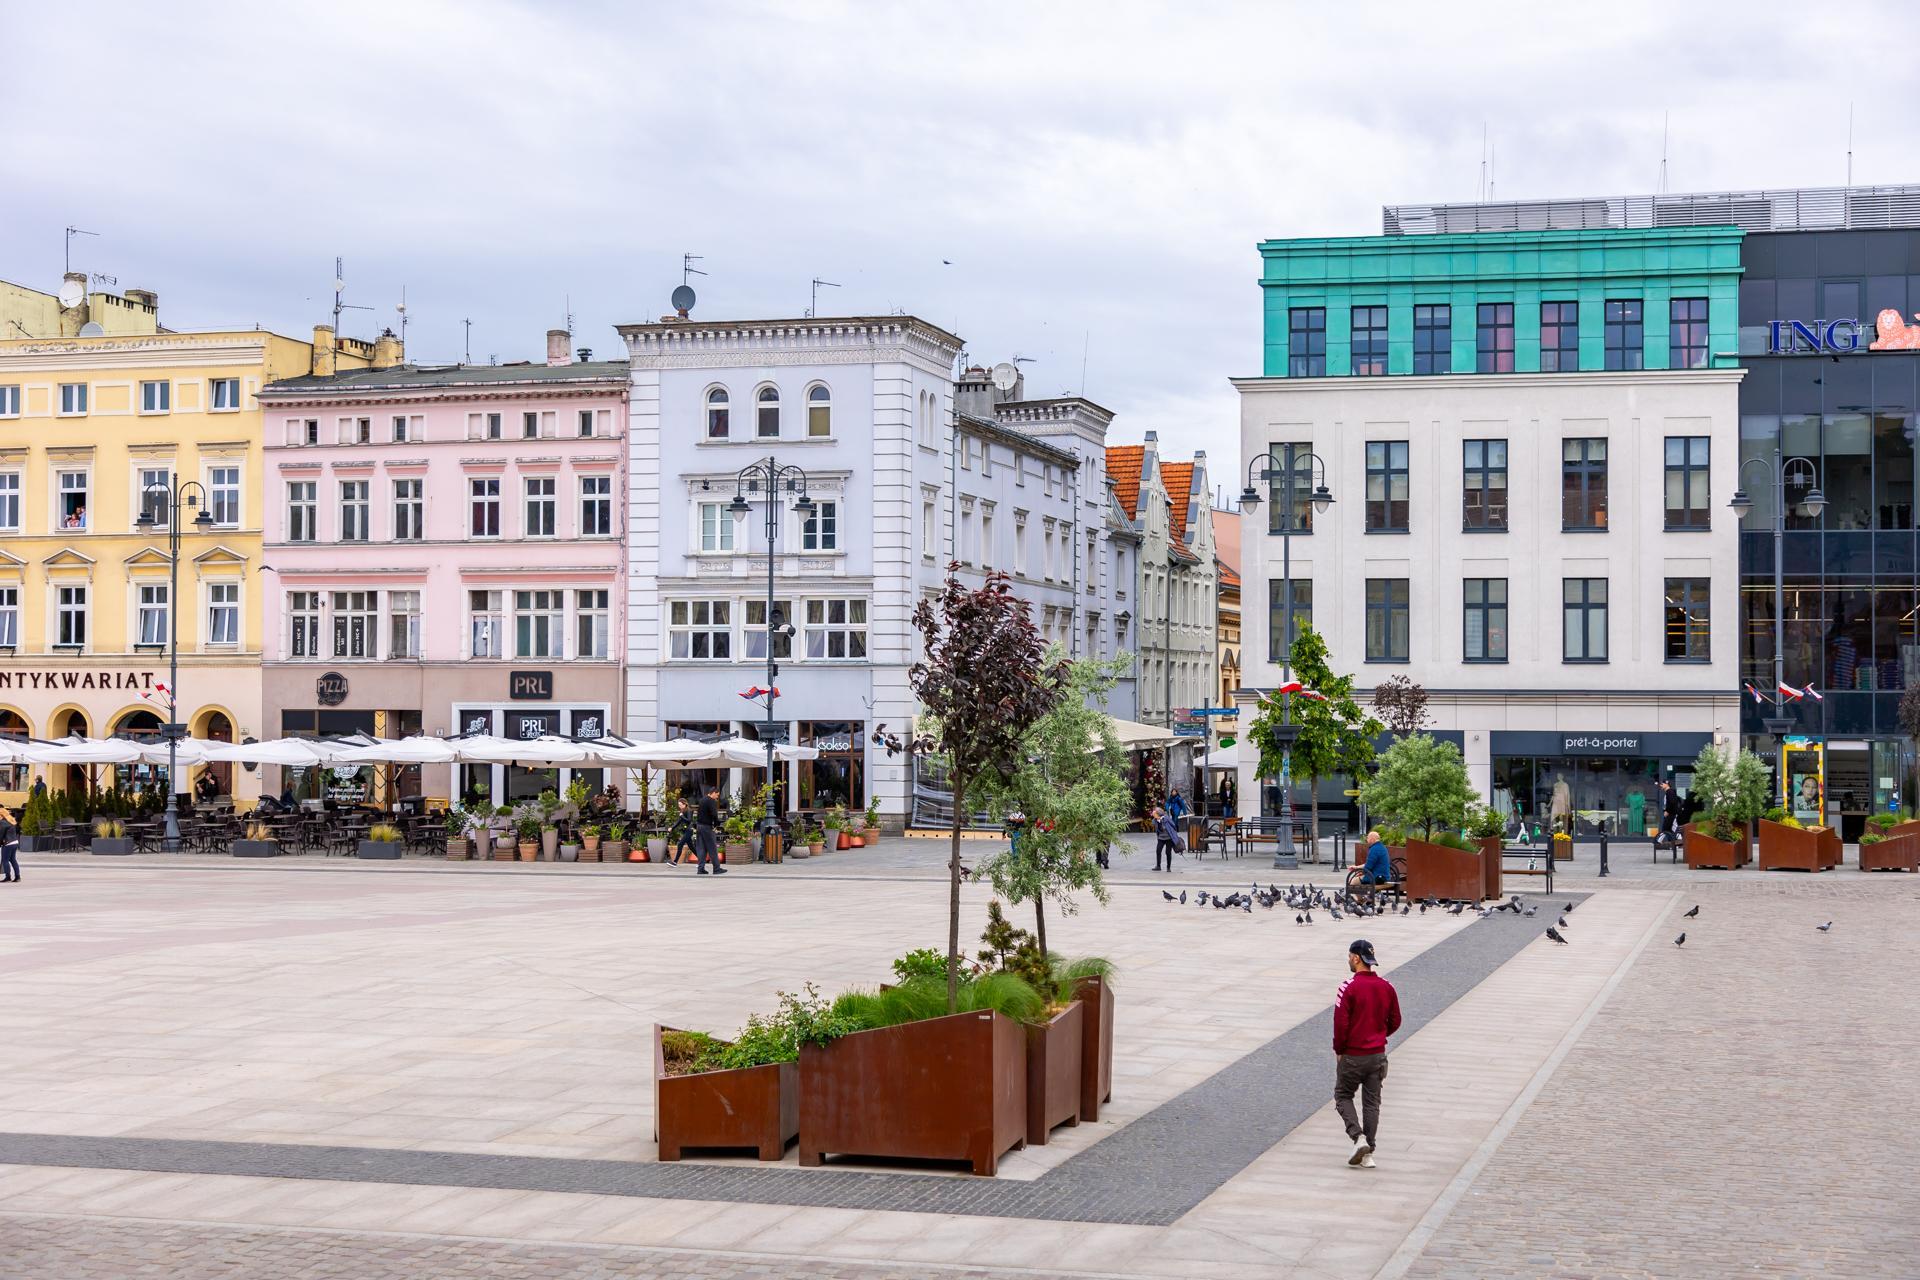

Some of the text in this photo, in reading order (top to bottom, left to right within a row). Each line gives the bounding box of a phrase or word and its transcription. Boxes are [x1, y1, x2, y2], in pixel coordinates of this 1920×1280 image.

[1768, 318, 1859, 353] ING
[0, 672, 154, 689] NTYKWARIAT
[317, 679, 347, 693] PIZZA
[514, 676, 548, 694] PRL
[521, 719, 545, 732] PRL
